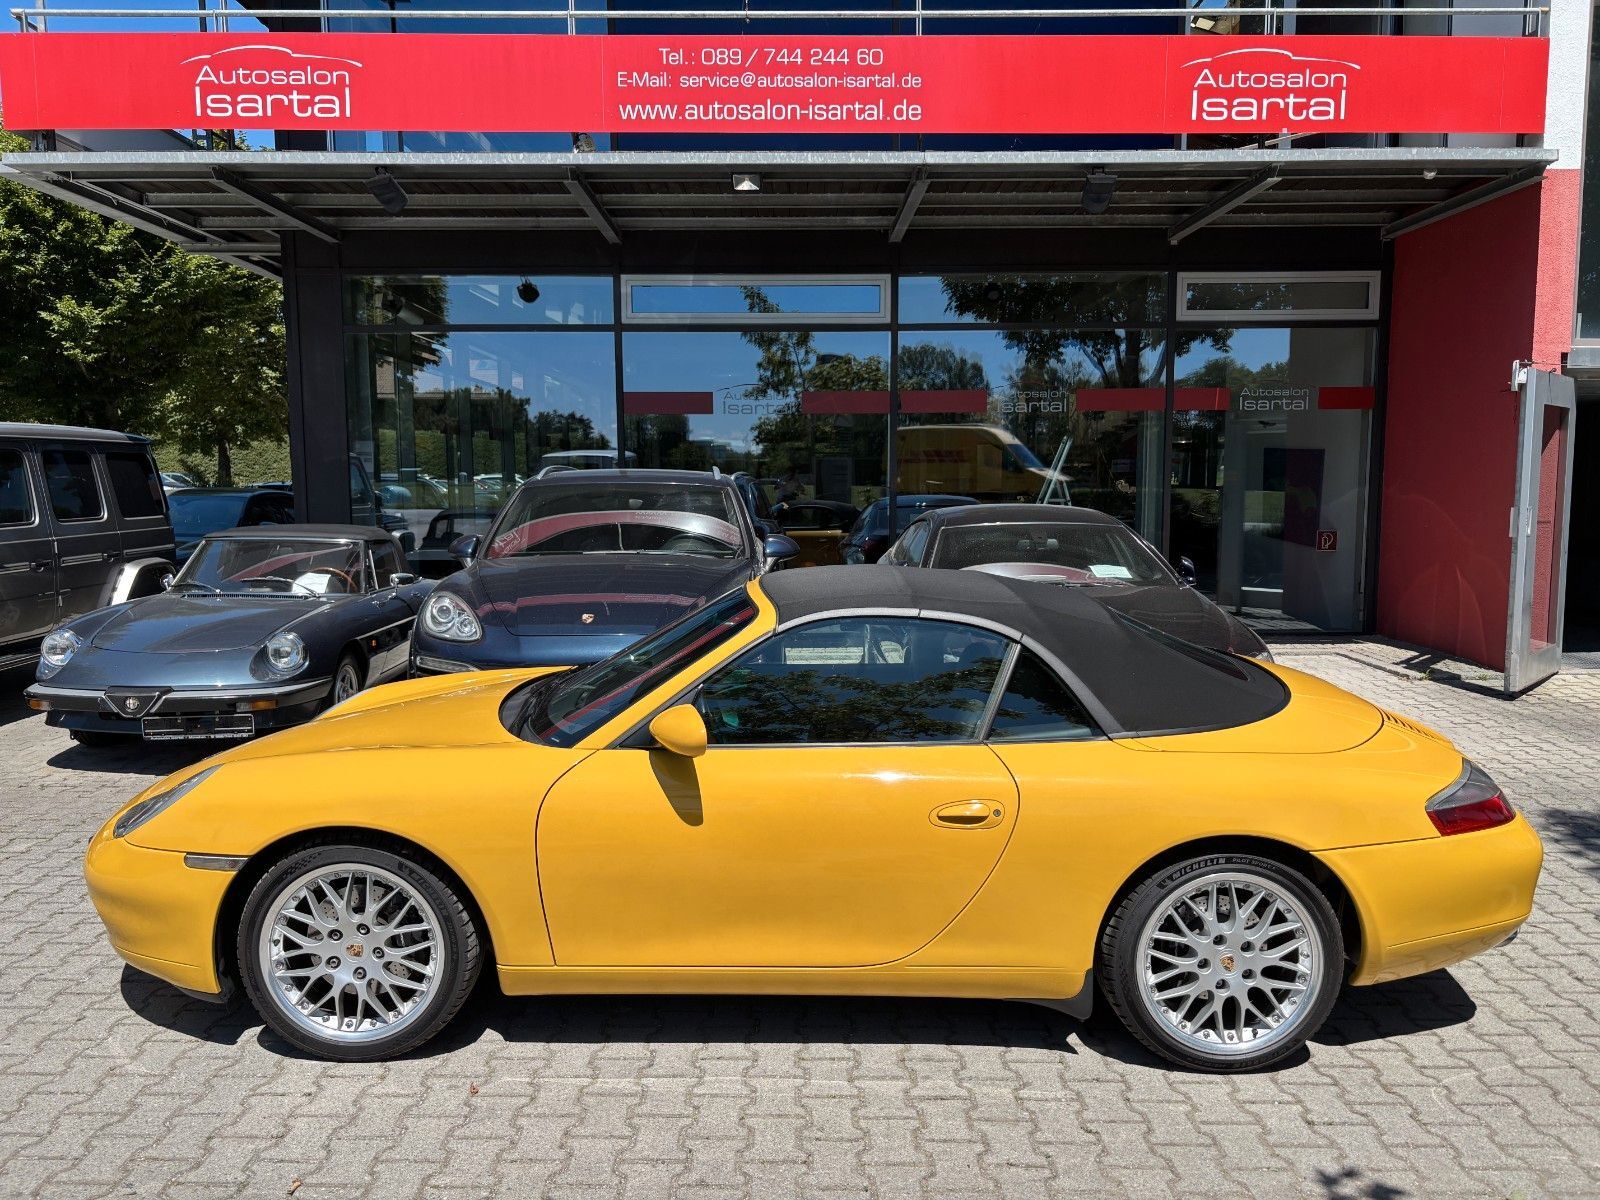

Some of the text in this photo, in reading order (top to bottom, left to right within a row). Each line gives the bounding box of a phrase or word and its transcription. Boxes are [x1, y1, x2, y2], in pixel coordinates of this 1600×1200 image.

[658, 47, 696, 66] Tel.:
[701, 47, 743, 66] 089
[763, 48, 803, 66] 744
[810, 48, 850, 66] 244
[856, 48, 884, 66] 60
[195, 65, 350, 86] Autosalon
[617, 71, 922, 89] E-Mail: service@autosalon-isartal.de
[1193, 67, 1348, 88] Autosalon
[194, 86, 352, 119] Isartal
[618, 98, 923, 121] www.autosalon-isartal.de
[1190, 89, 1347, 121] Isartal
[1240, 387, 1309, 397] Autosalon
[1239, 396, 1309, 411] Isartal
[1171, 857, 1226, 881] MICHELIN
